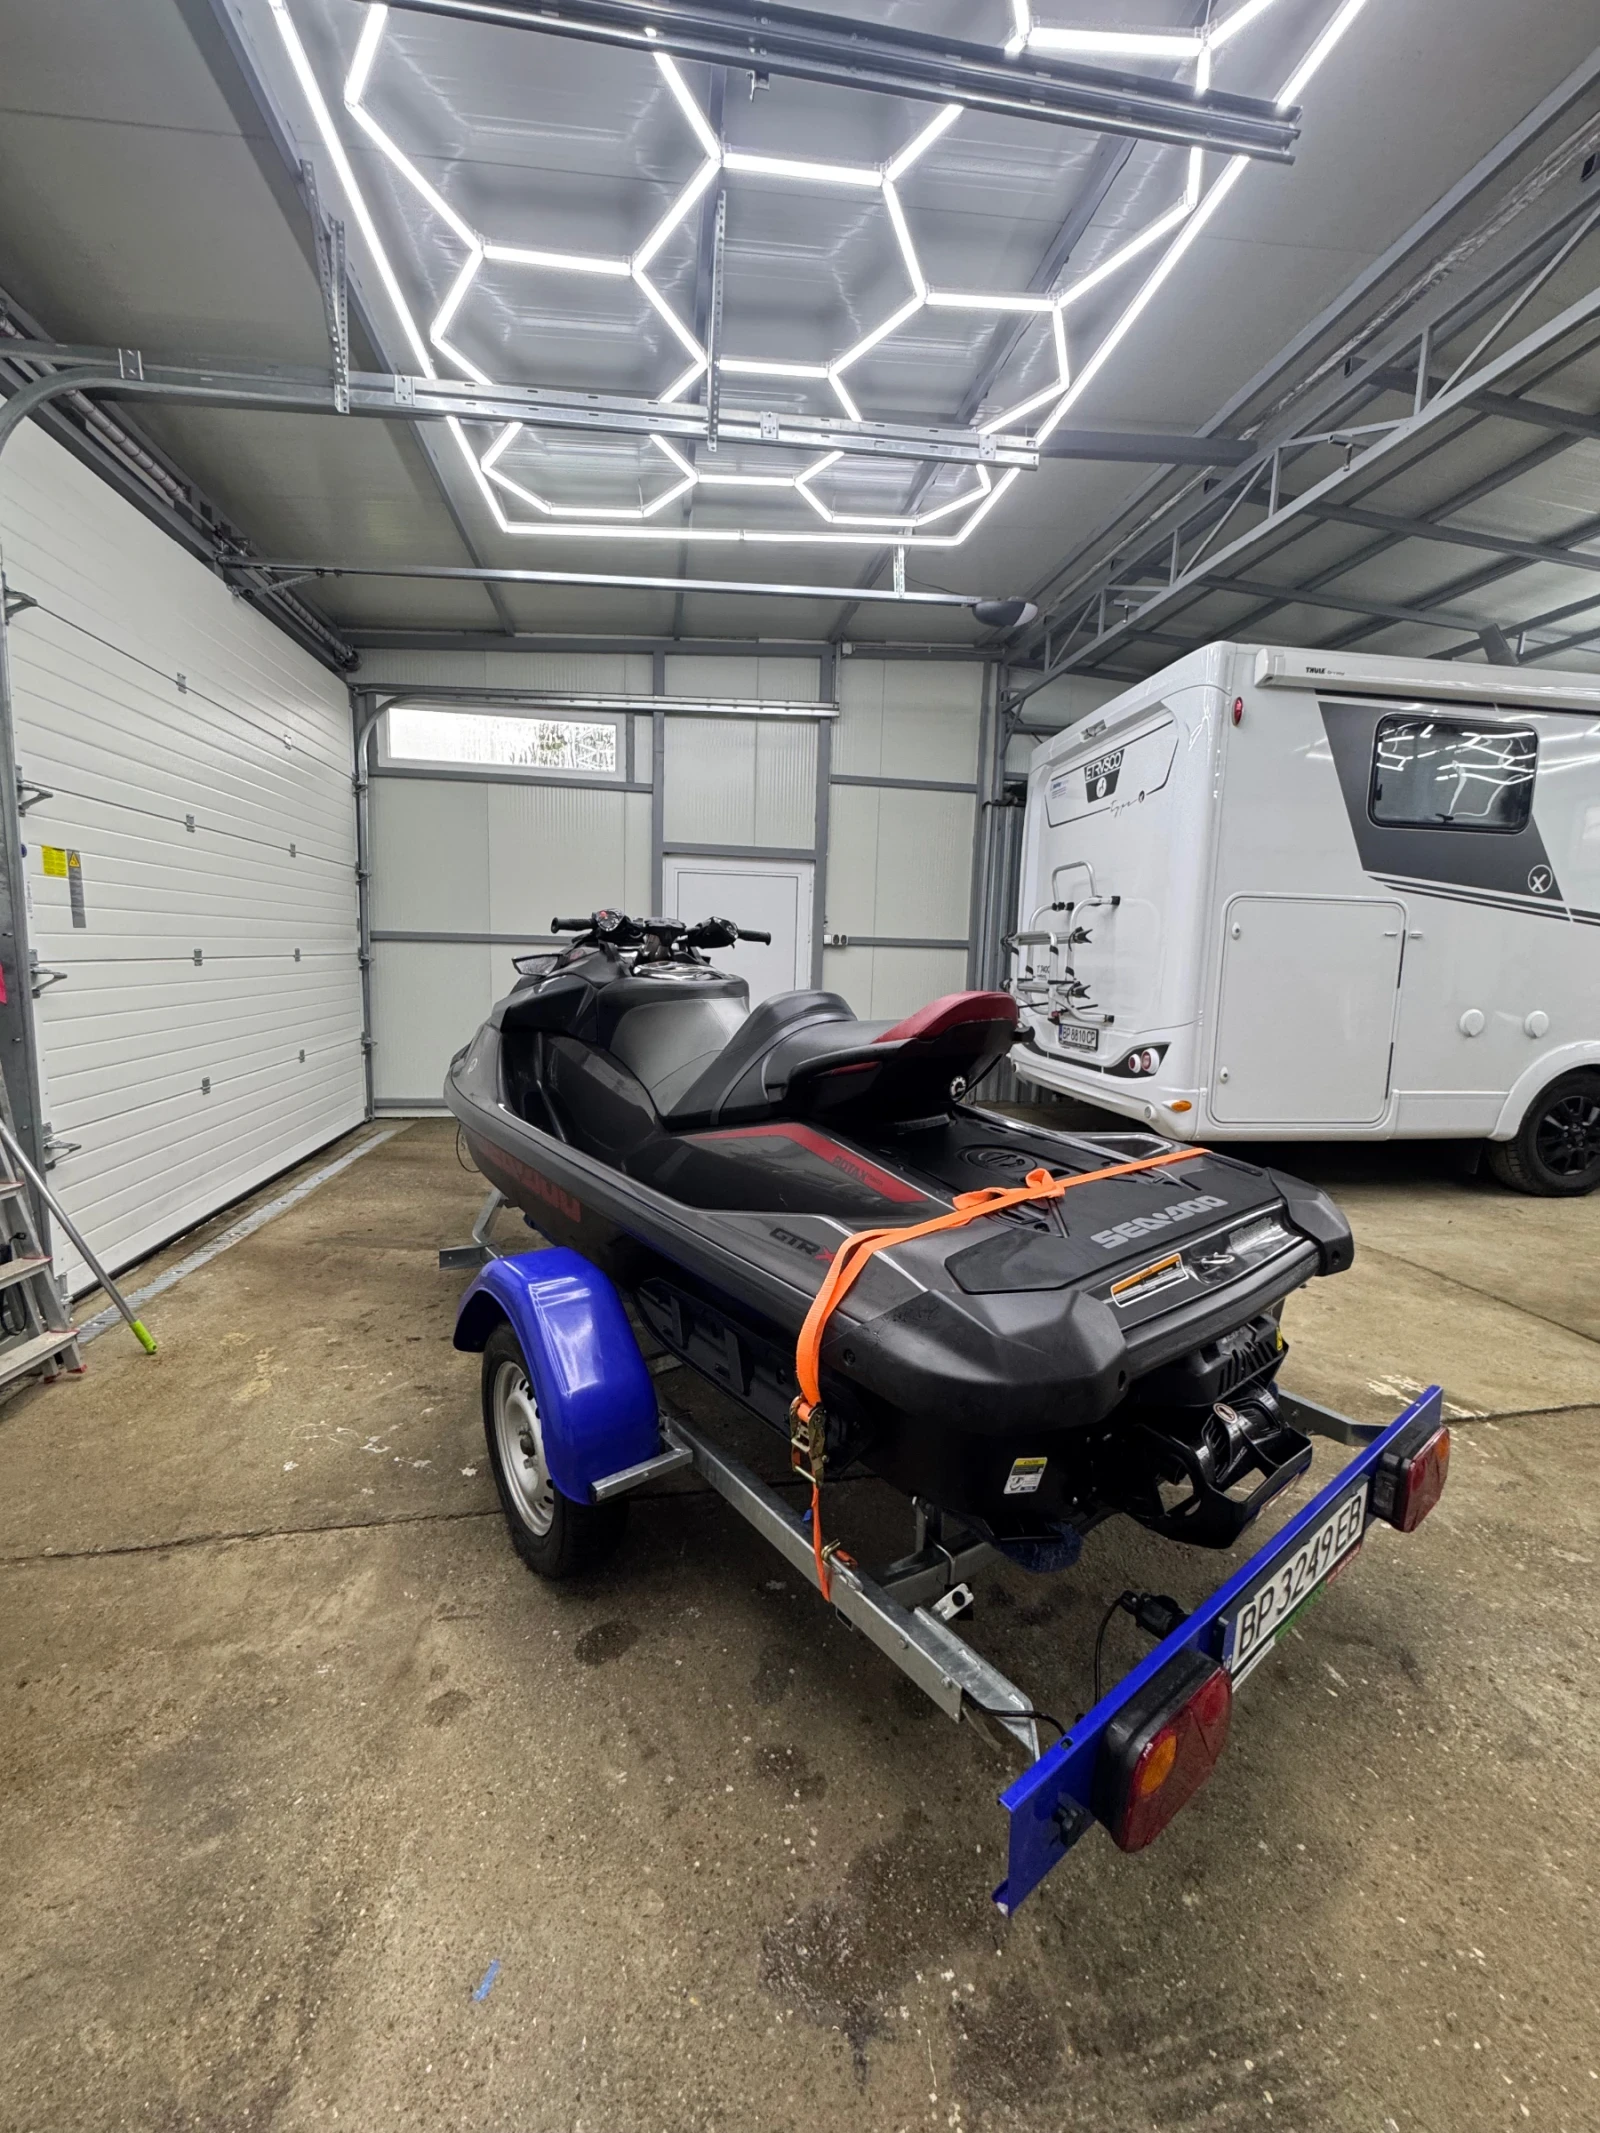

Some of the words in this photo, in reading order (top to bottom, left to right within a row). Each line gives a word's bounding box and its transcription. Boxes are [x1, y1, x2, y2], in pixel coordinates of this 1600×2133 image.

[1305, 666, 1326, 675] THULE
[832, 1155, 868, 1182] ROTAX
[1276, 1525, 1334, 1616] 3249
